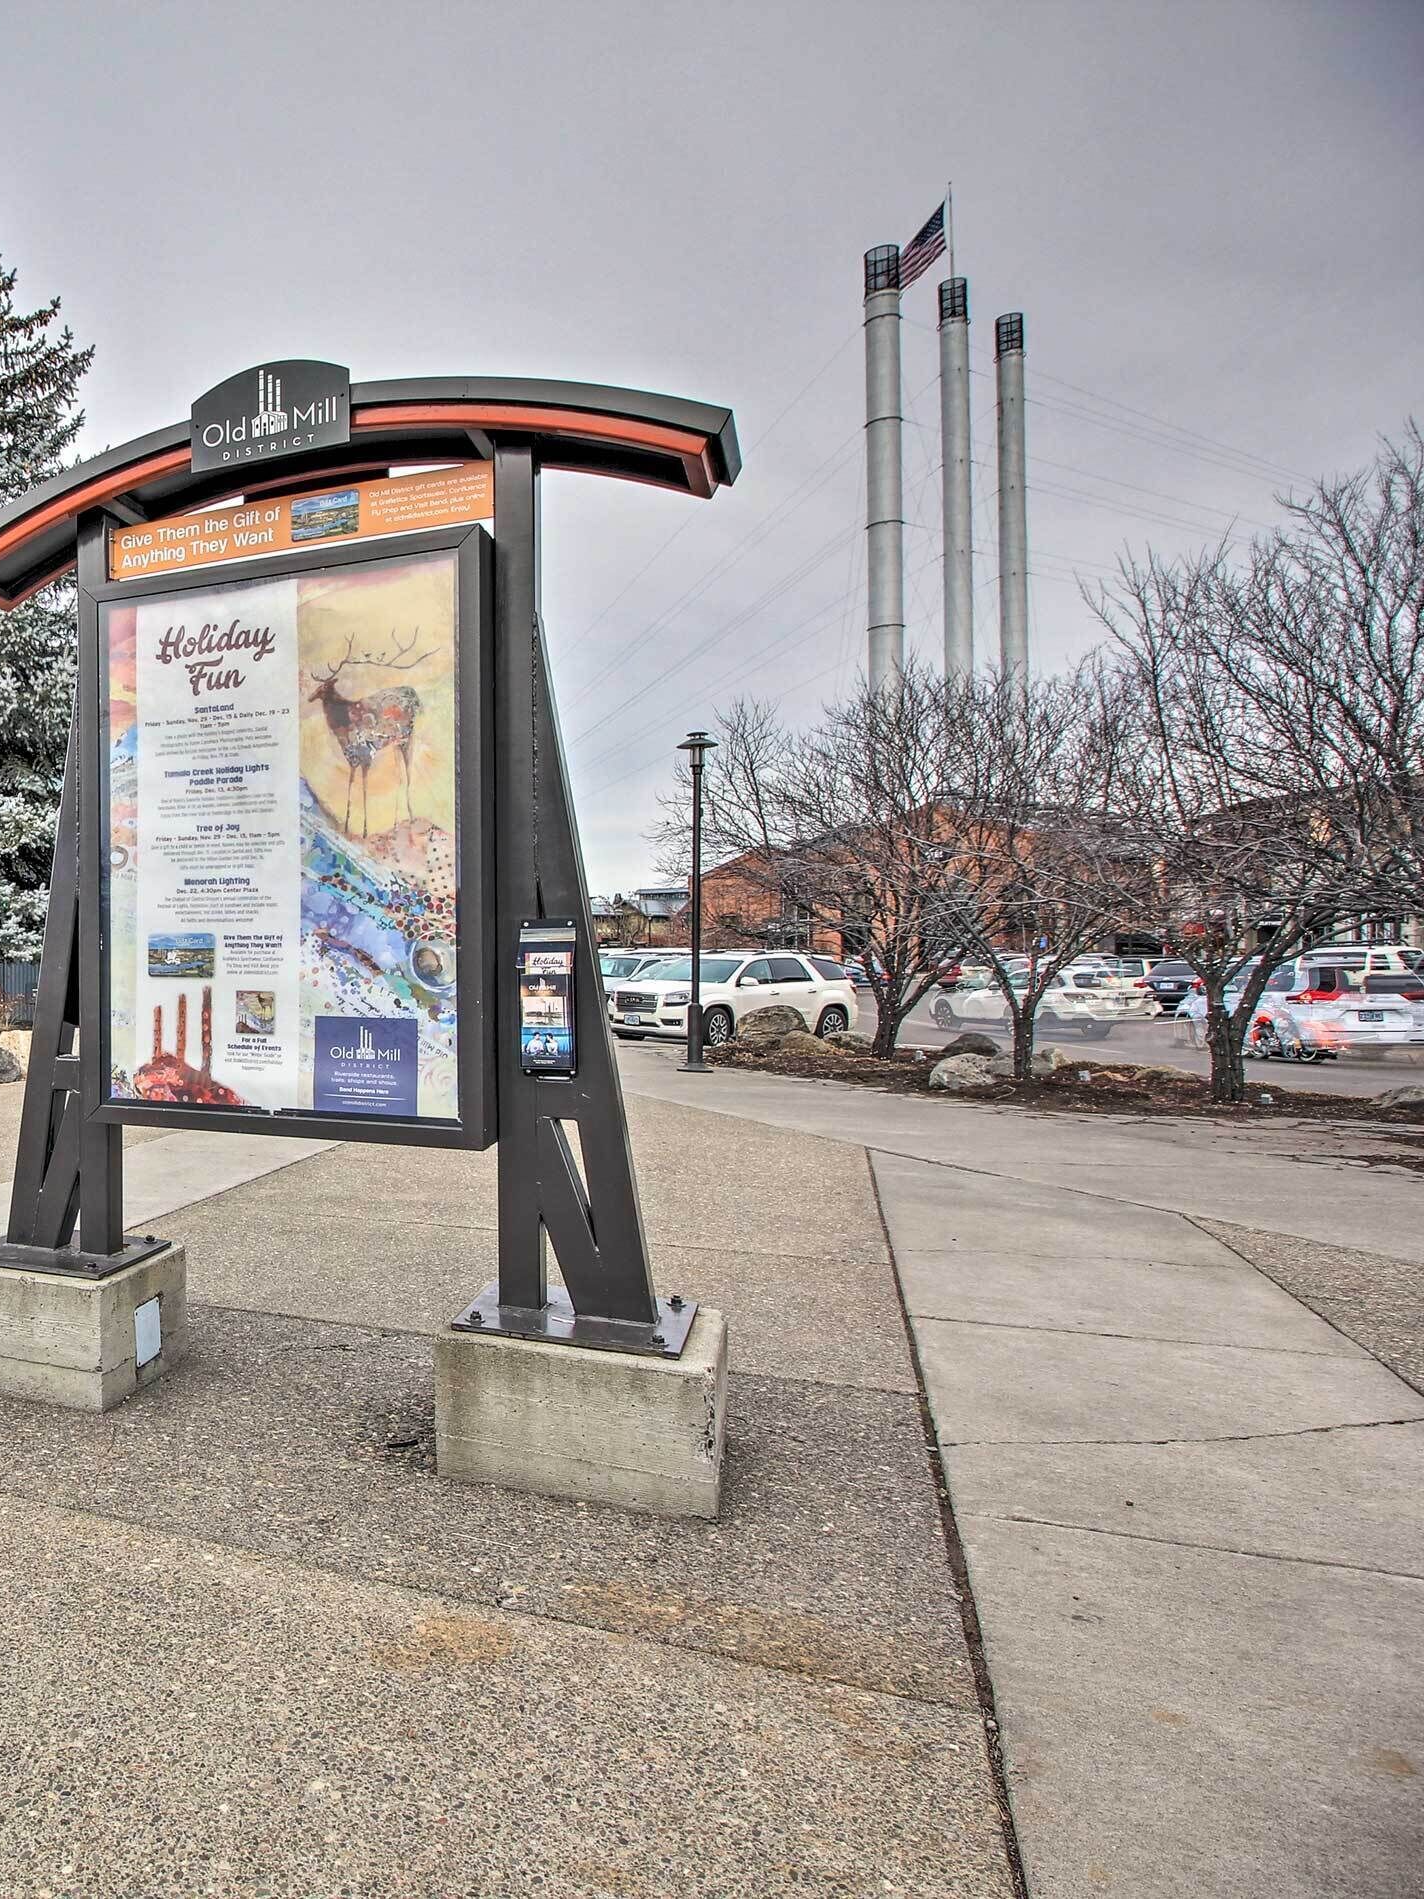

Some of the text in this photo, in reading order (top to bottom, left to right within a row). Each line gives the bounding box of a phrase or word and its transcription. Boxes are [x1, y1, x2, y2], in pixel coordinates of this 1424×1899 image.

[202, 396, 337, 447] Old Mill
[222, 433, 315, 461] DISTRICT
[121, 506, 281, 550] Give Them the Gift of
[121, 527, 275, 569] Anything They Want
[155, 619, 276, 665] Holiday
[185, 654, 247, 696] Fun
[194, 703, 235, 714] SantaLand
[192, 767, 214, 776] Creek
[215, 764, 244, 775] Holiday
[245, 763, 270, 774] Lights
[189, 775, 243, 786] Paddle Parade
[196, 823, 240, 834] Tree of Joy
[184, 877, 251, 887] Menorah Lighting
[532, 956, 564, 968] Holiday
[254, 1044, 261, 1052] of
[261, 1044, 282, 1052] Events
[329, 1046, 400, 1062] Old Mill
[340, 1062, 391, 1070] DISTRICT
[353, 1087, 376, 1095] Happens
